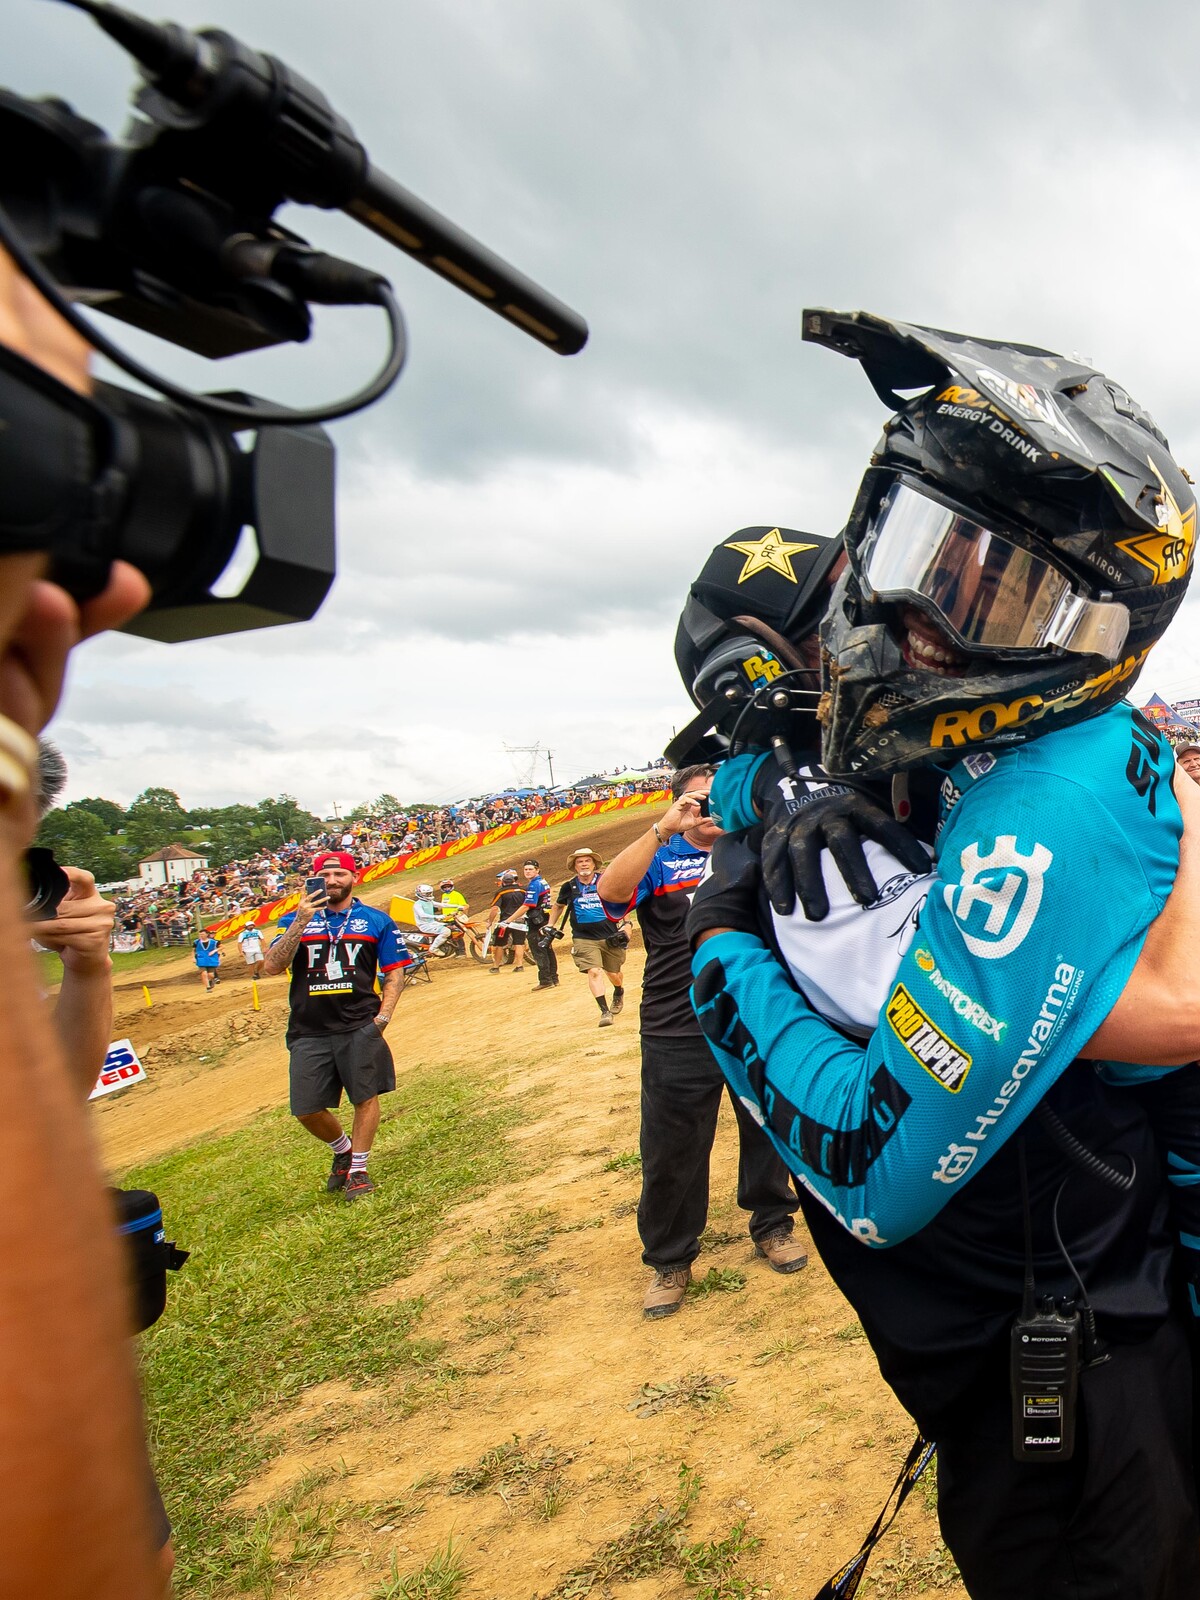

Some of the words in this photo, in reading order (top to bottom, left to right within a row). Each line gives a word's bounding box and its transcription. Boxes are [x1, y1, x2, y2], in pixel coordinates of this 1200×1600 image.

[936, 403, 994, 425] ENERGY
[988, 420, 1043, 464] DRINK
[1087, 551, 1123, 583] AIROH
[850, 729, 900, 772] AIROH
[1066, 968, 1086, 1011] RACING
[964, 960, 1076, 1141] Husqvarna
[1024, 1436, 1061, 1445] Scuba
